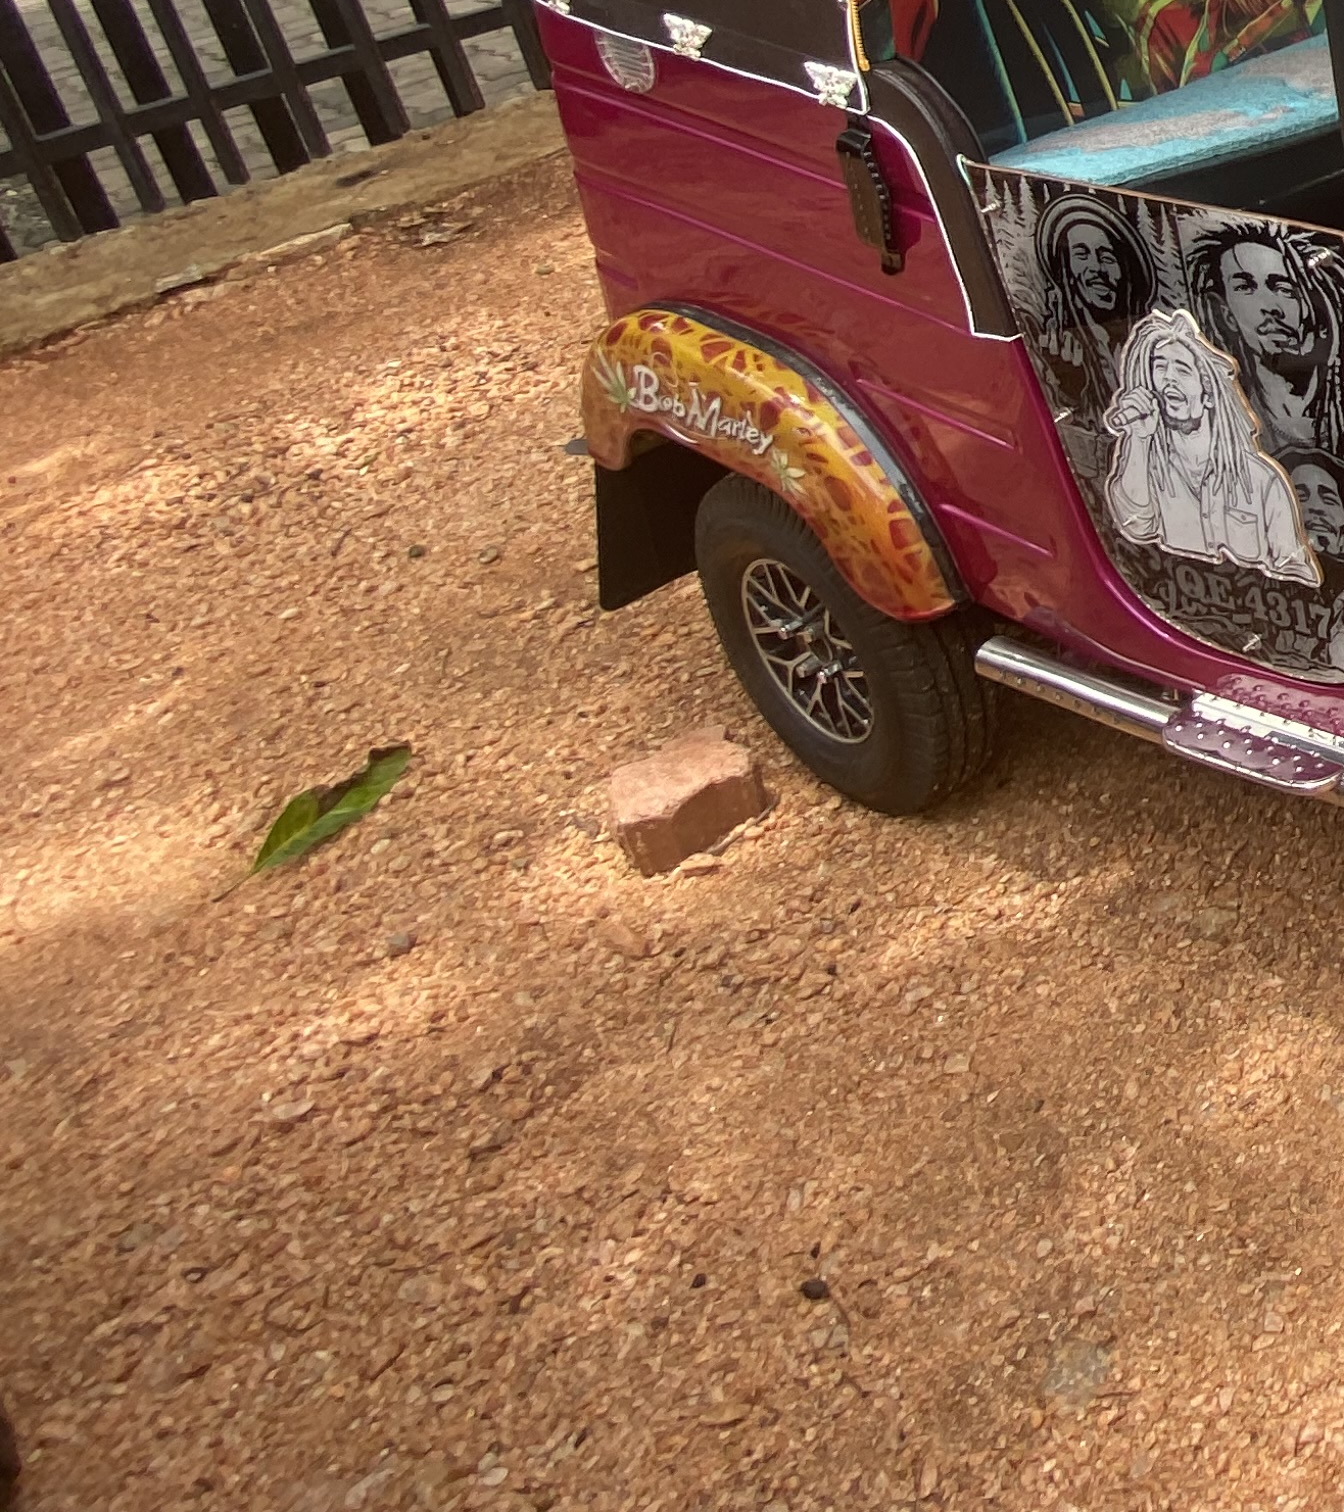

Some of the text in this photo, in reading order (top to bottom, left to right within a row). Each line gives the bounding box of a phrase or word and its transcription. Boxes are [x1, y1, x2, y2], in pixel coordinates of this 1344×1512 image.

[629, 364, 774, 455] Bob Marley
[1244, 586, 1331, 640] 4317
